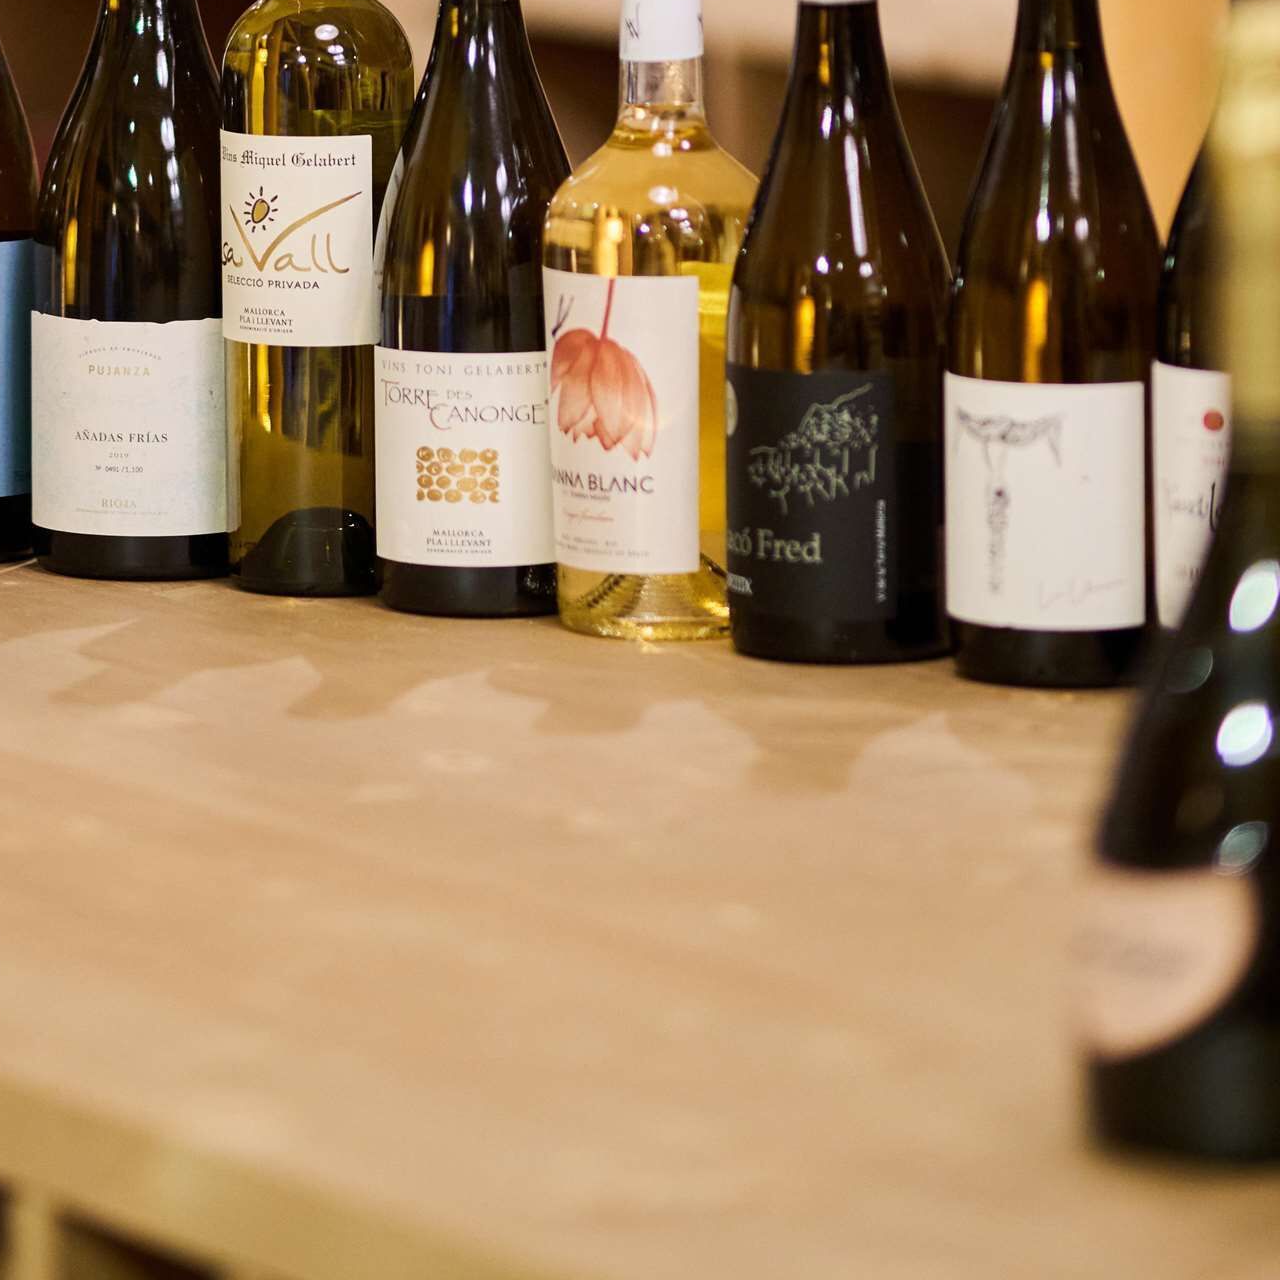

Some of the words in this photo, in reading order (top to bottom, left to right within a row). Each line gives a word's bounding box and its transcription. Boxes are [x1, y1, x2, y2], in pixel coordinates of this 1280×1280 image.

[240, 149, 287, 169] Miquel
[291, 152, 356, 168] Gelabert
[226, 273, 264, 289] SELECCIÓ
[268, 279, 321, 290] PRIVADA
[243, 306, 287, 317] MALLORCA
[239, 314, 252, 325] PLA
[256, 317, 294, 327] LLEVANT
[87, 363, 151, 377] PUJANZA
[381, 359, 406, 374] VINS
[415, 363, 453, 376] TONI
[380, 378, 439, 410] TORRE
[445, 389, 473, 400] DES
[429, 400, 546, 431] CANONGE
[74, 428, 124, 443] AÑADAS
[128, 431, 169, 444] FRÍAS
[587, 473, 655, 494] BLANC
[100, 497, 138, 509] RIOJA
[432, 528, 485, 537] MALLORCA
[756, 527, 824, 564] Fred
